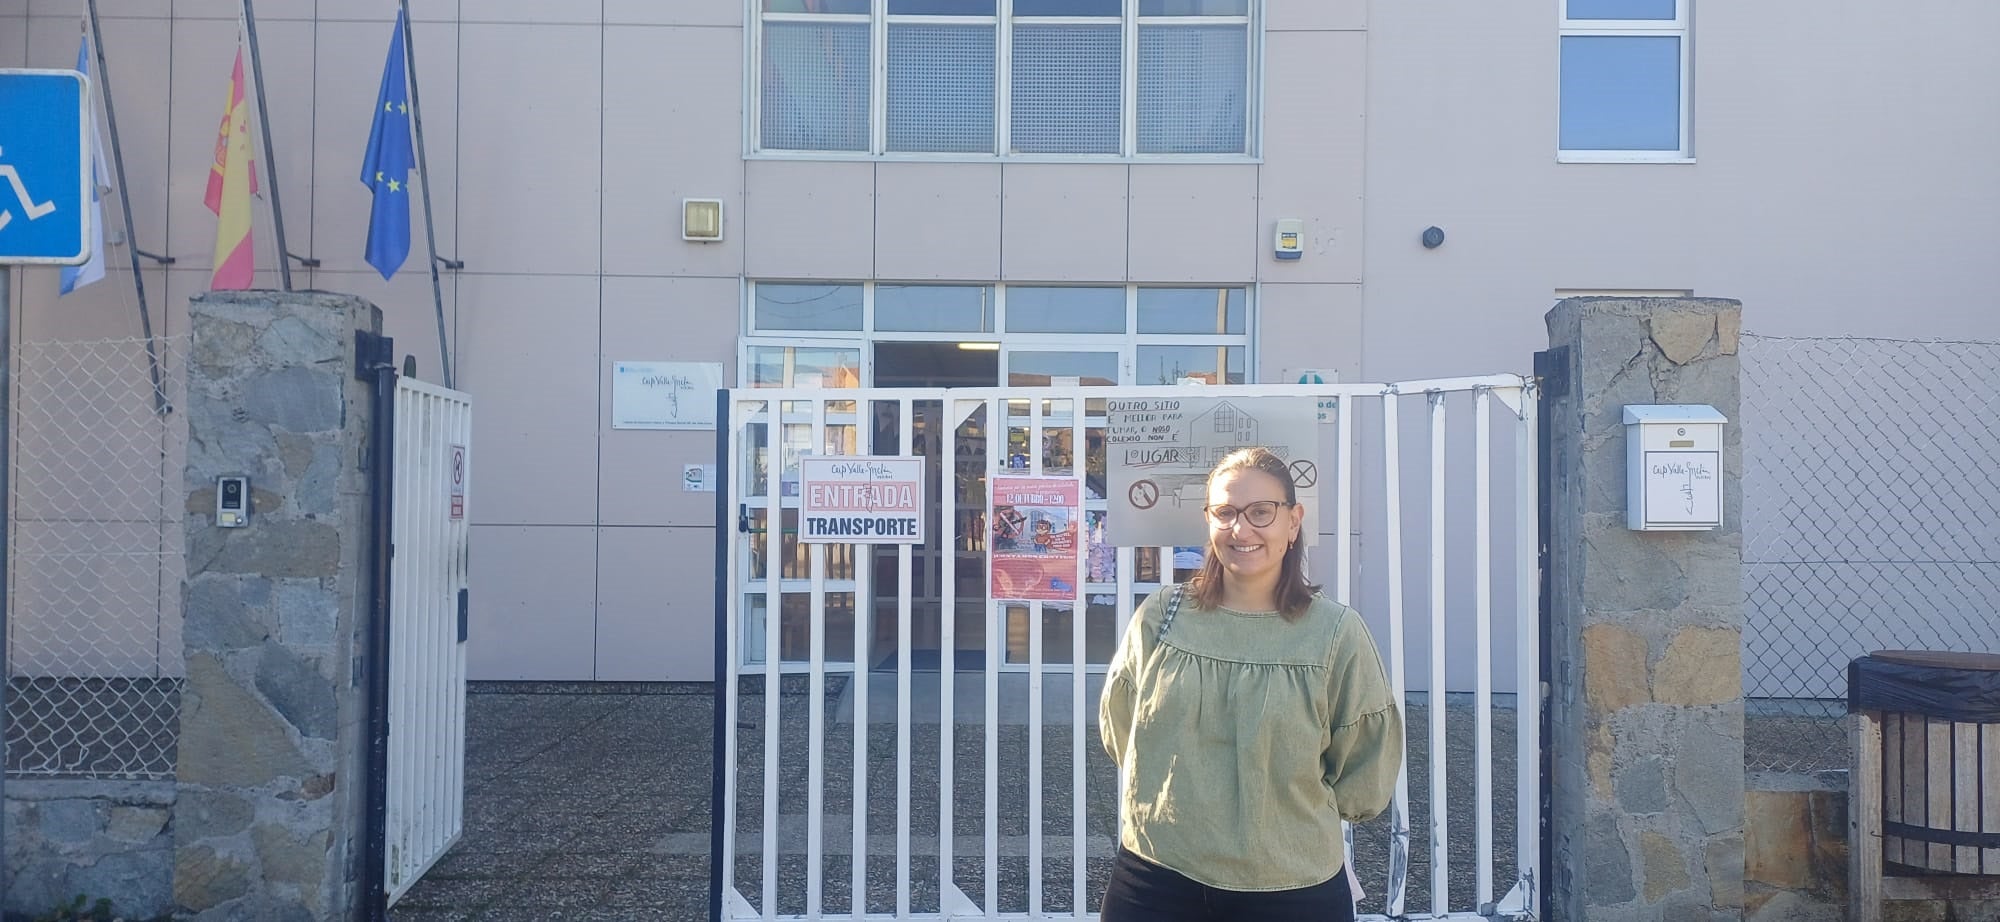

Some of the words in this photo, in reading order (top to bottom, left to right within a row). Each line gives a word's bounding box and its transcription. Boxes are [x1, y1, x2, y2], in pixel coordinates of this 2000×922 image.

[1108, 401, 1147, 411] OUTRO
[1154, 400, 1180, 411] SITIO
[1152, 425, 1171, 433] NOSO
[810, 484, 913, 509] ENTRADA
[807, 518, 917, 536] TRANSPORTE
